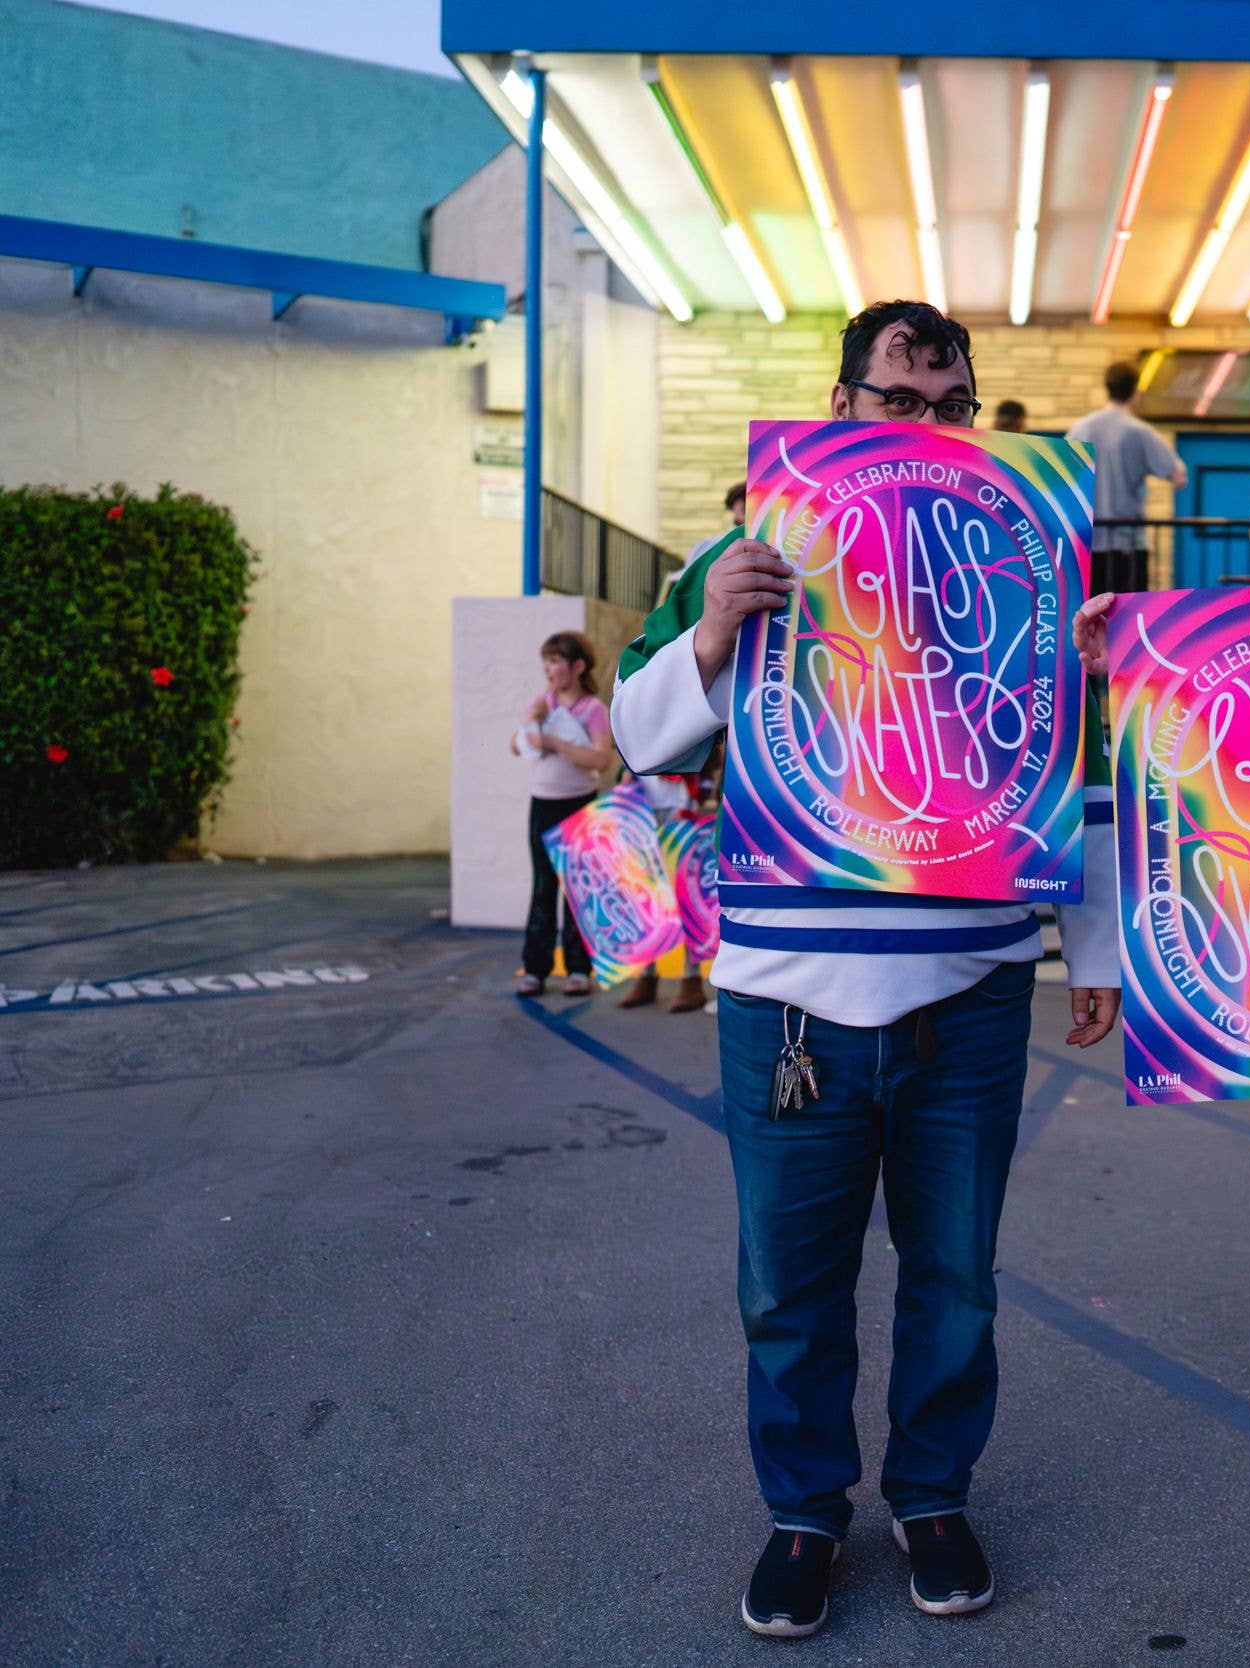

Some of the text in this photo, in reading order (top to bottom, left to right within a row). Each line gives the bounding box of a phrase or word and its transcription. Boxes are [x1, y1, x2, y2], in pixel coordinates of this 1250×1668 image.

[772, 614, 791, 628] A
[825, 461, 962, 506] CELEBRATION
[977, 484, 1010, 514] OF
[1010, 518, 1053, 583] PHILIP
[1035, 592, 1058, 655] GLASS
[777, 496, 998, 652] GLASS
[744, 618, 1032, 823] SKATES
[764, 649, 811, 787] MOONLIGHT
[809, 794, 940, 852] ROLLERWAY
[963, 676, 1054, 840] MARCH 17, 2024
[1148, 703, 1192, 802] MOVING
[732, 853, 748, 865] LA
[1014, 878, 1068, 892] INSIGHT
[1153, 819, 1171, 835] A
[1148, 857, 1209, 999] MOONLIGHT
[1138, 1076, 1154, 1088] LA
[1157, 1073, 1181, 1086] Phil
